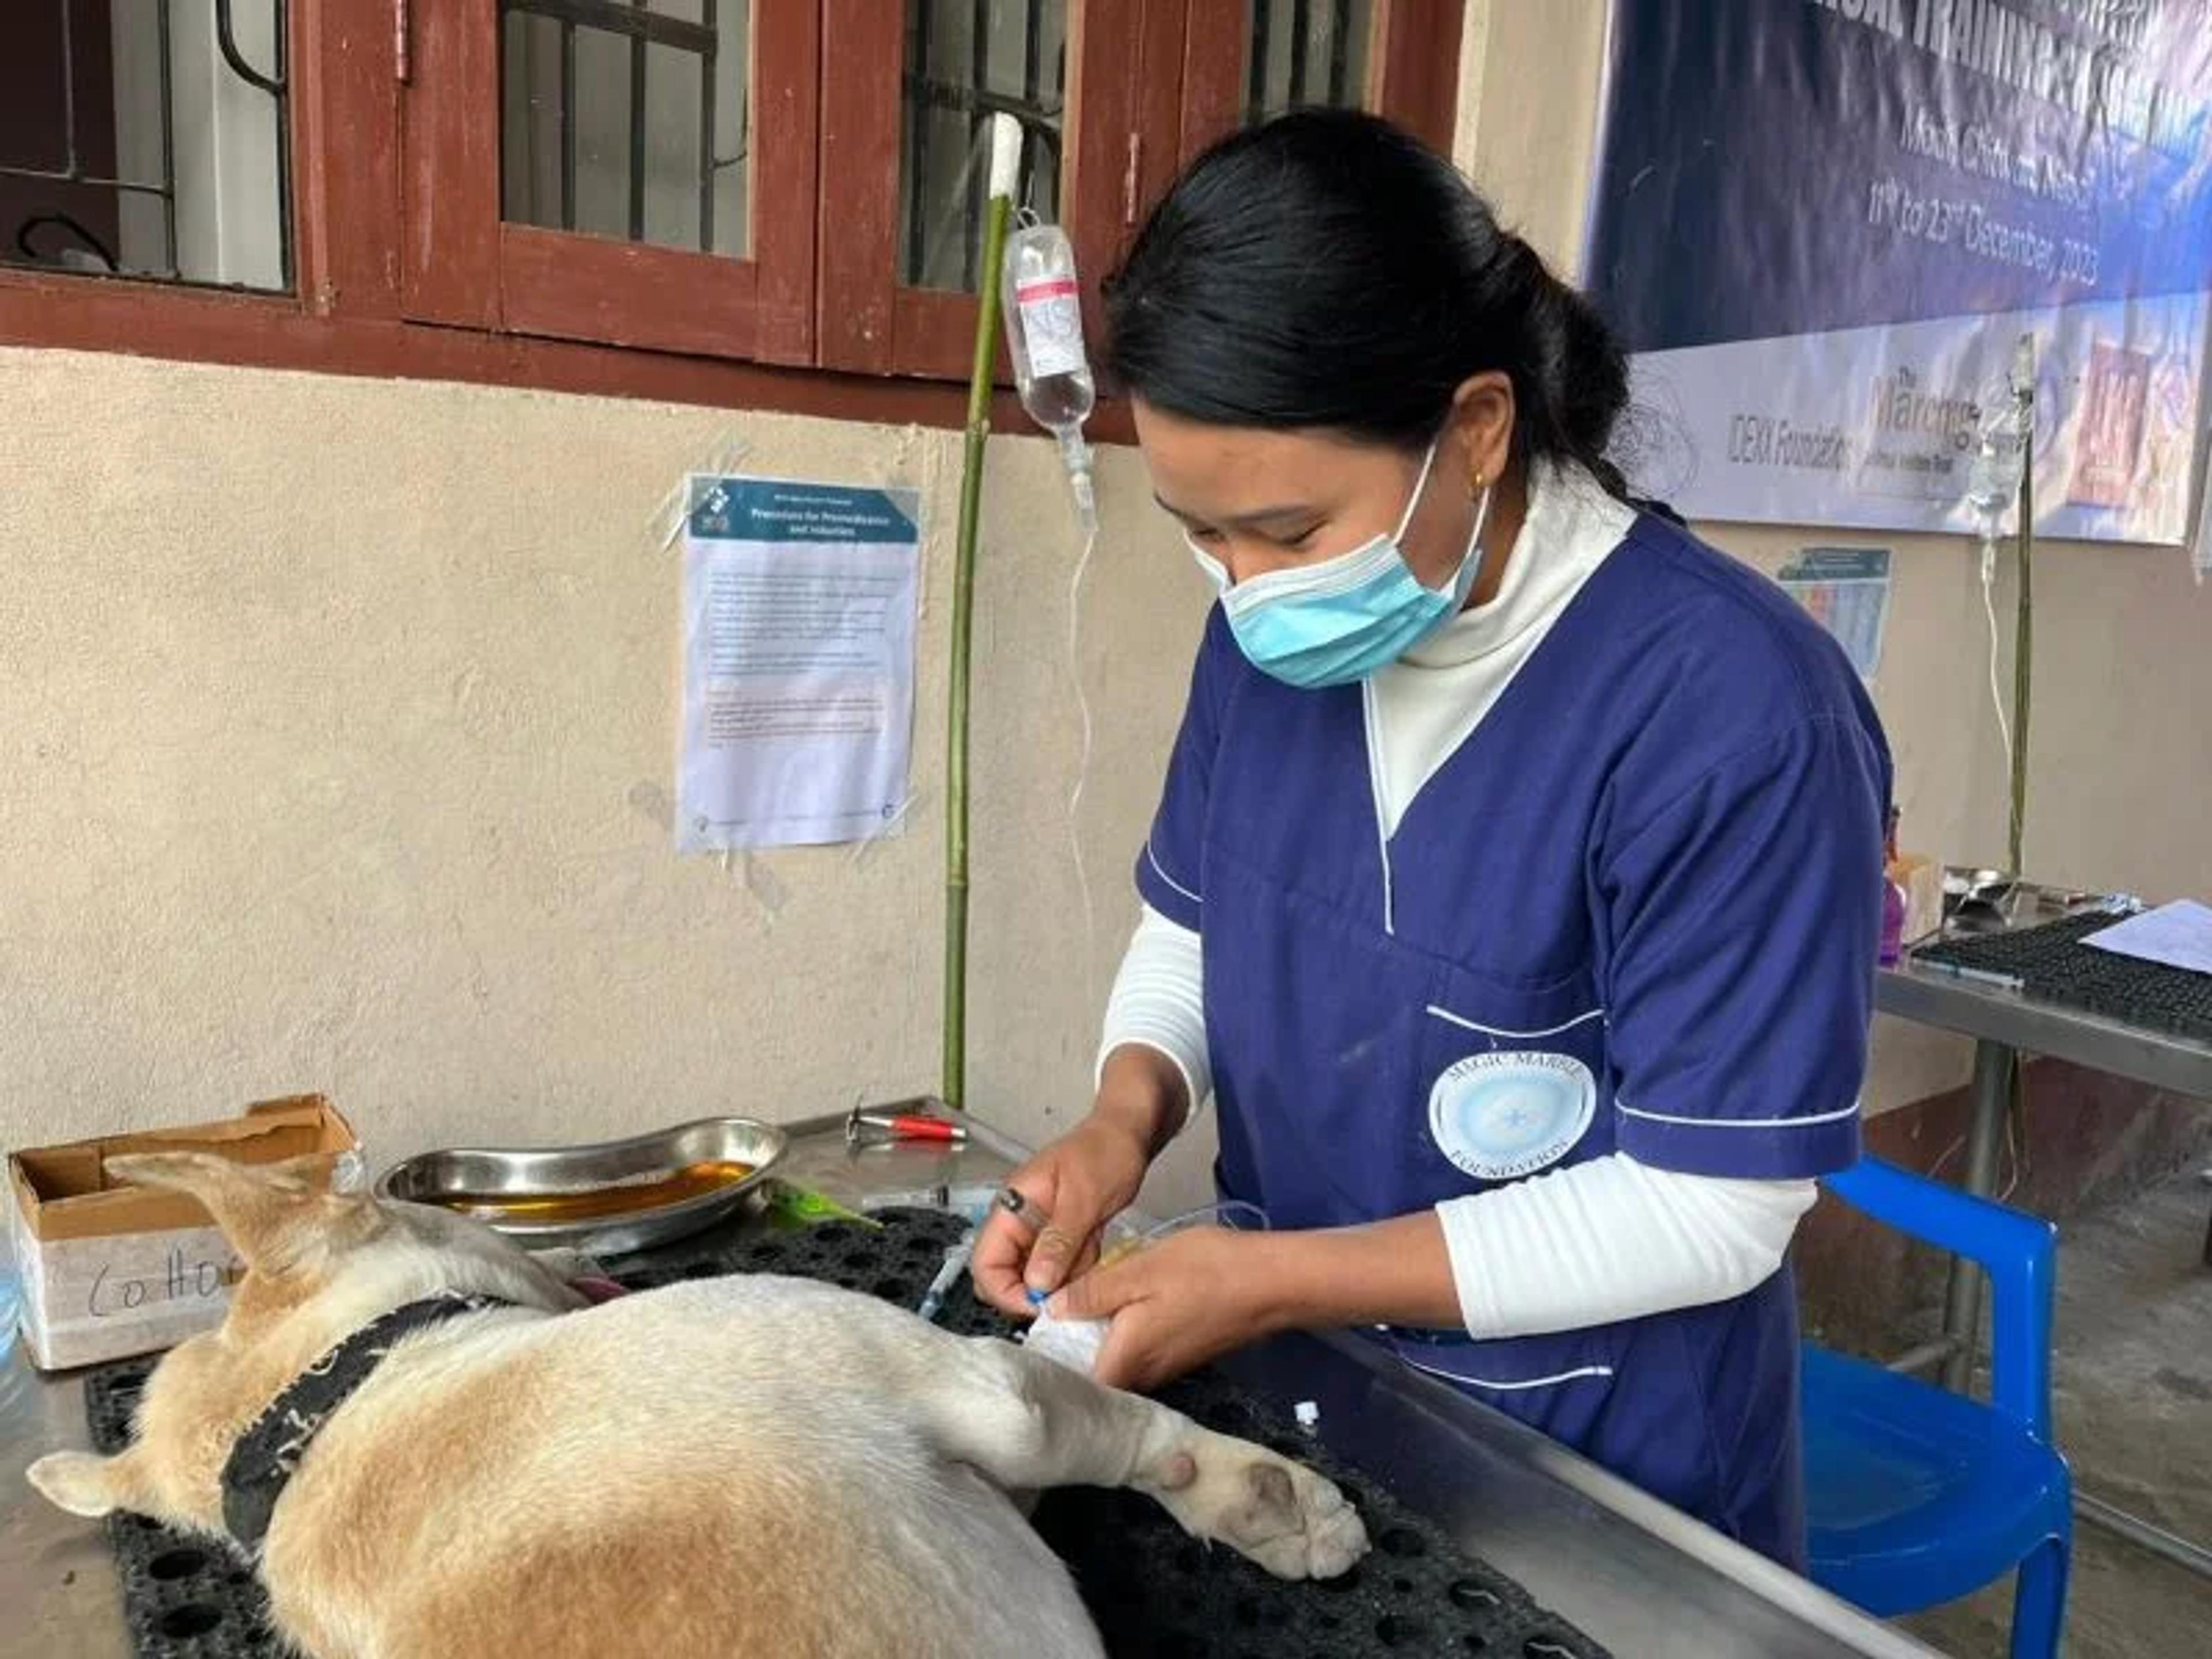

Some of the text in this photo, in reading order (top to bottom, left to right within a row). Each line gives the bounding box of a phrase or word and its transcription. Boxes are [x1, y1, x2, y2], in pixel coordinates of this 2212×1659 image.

[1902, 191, 1926, 237] to
[2059, 239, 2099, 286] 2023
[1773, 419, 1853, 472] Foundatio
[1449, 1052, 1505, 1083] MAGIC
[1450, 1142, 1570, 1177] FOUNDATION
